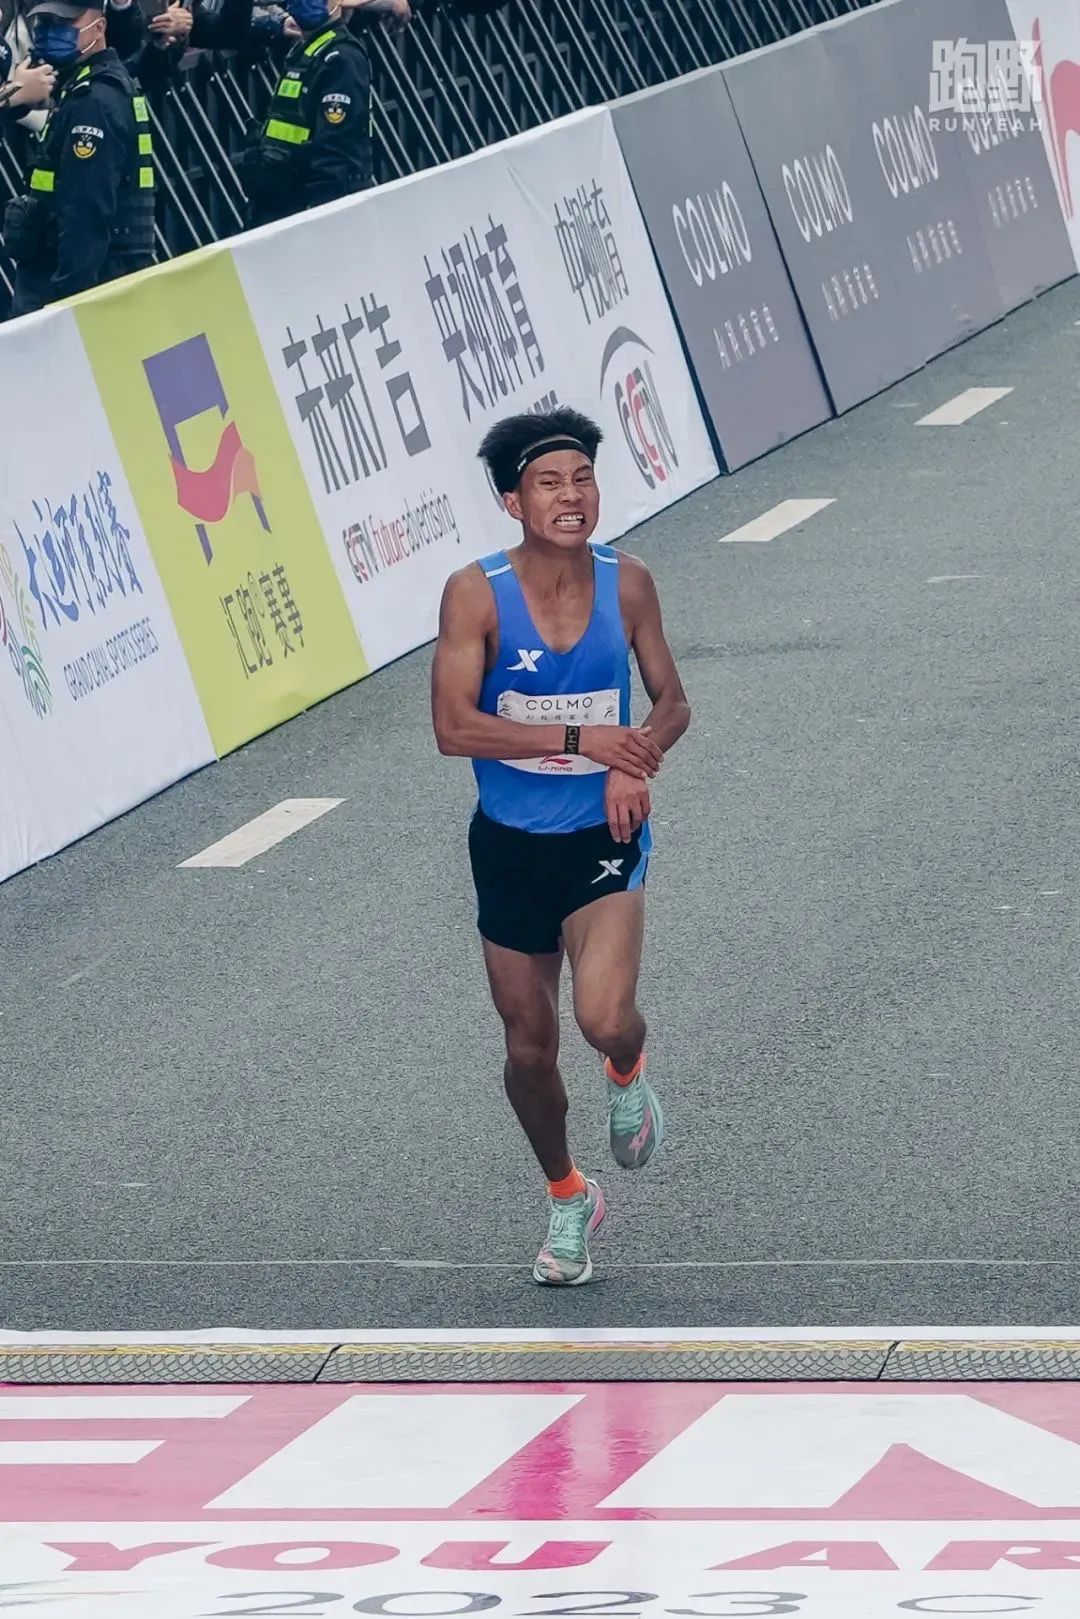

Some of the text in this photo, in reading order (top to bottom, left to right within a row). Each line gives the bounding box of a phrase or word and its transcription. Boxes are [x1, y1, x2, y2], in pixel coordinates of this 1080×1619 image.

[782, 142, 854, 243] COLMO
[872, 104, 939, 199] COLMO
[672, 179, 752, 287] COLMO
[424, 213, 545, 424] 央视体育
[282, 292, 432, 495] 未来广告
[525, 696, 593, 711] COLMO
[42, 1541, 614, 1571] YOU
[195, 1590, 809, 1616] 2023
